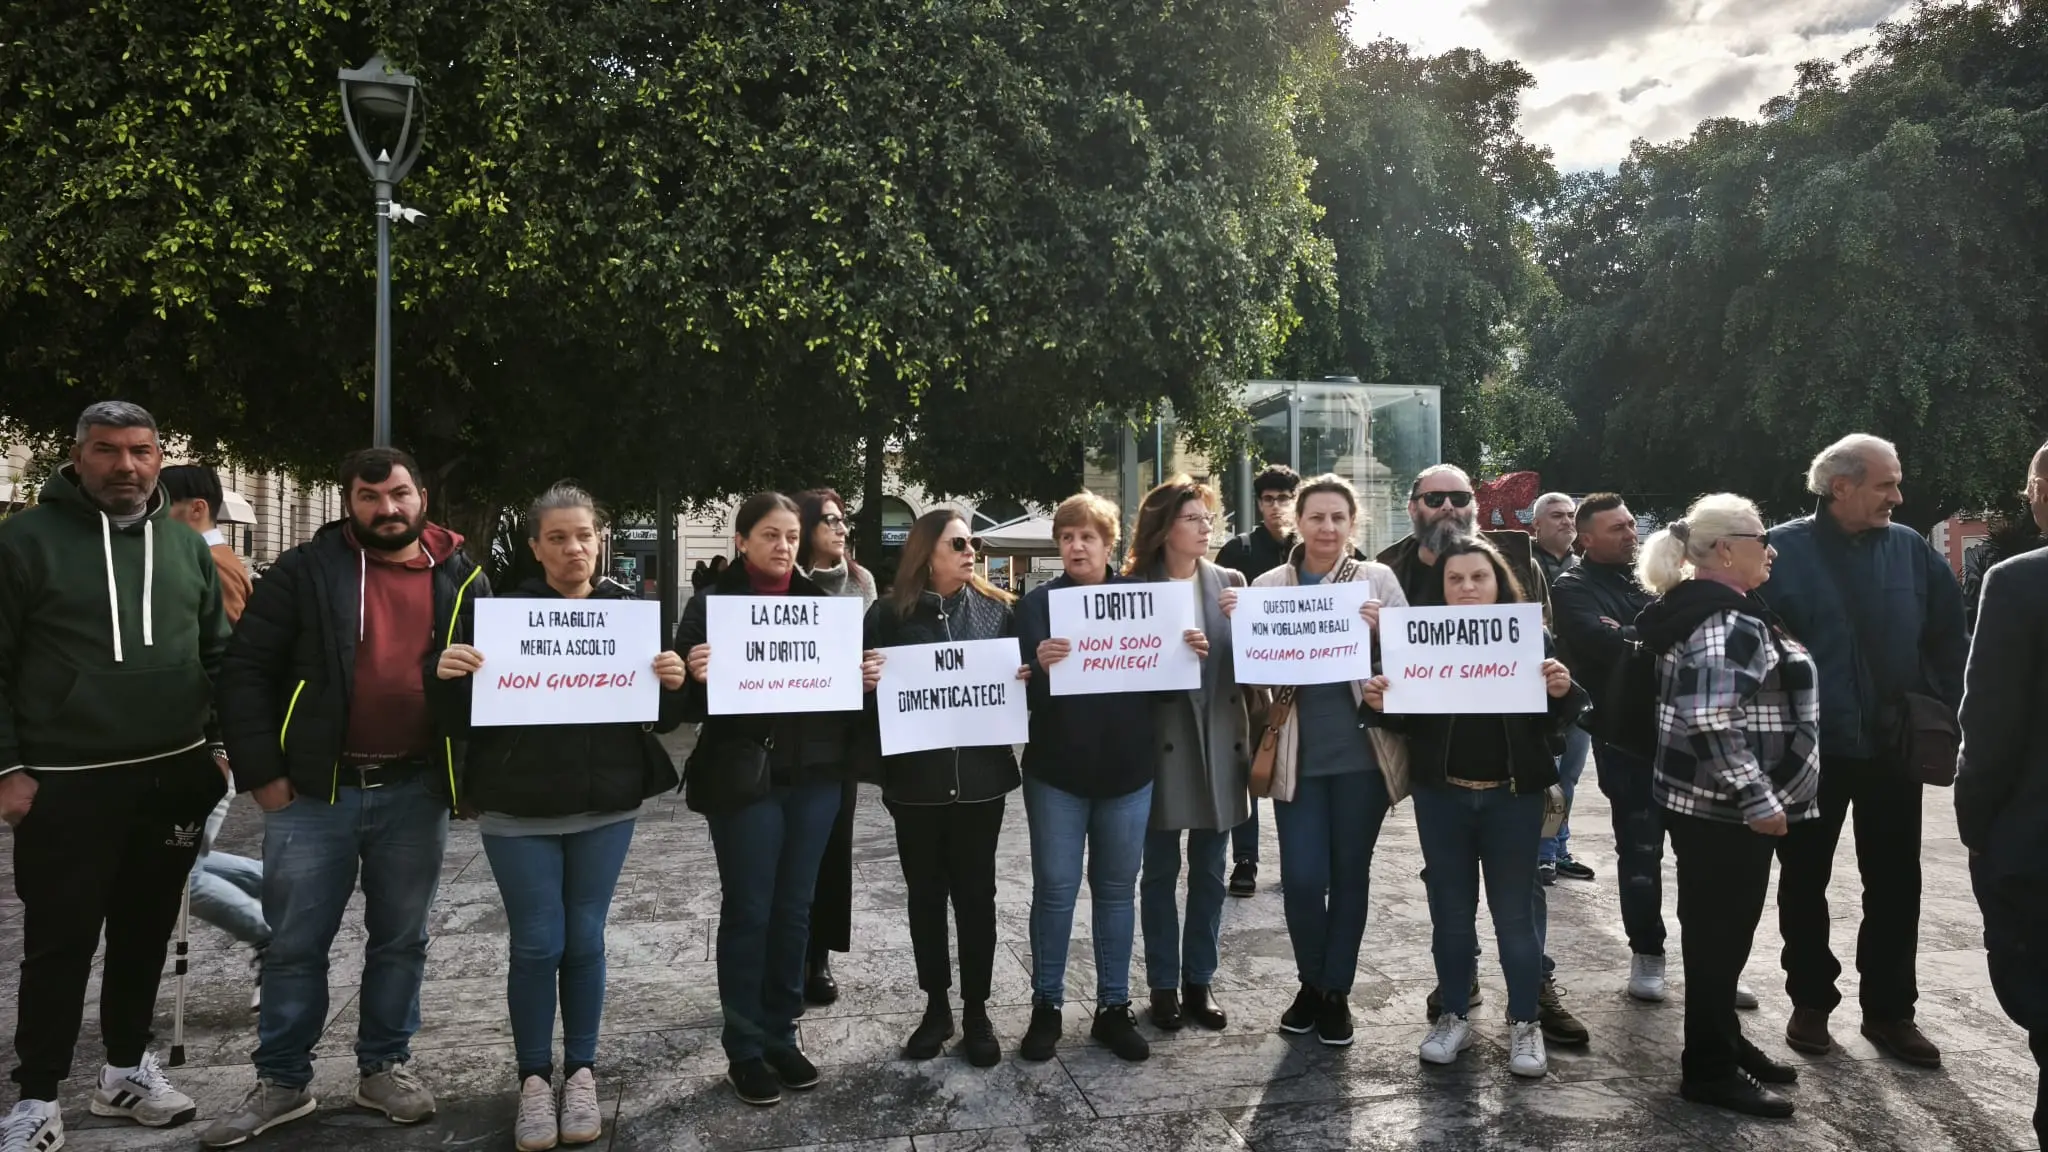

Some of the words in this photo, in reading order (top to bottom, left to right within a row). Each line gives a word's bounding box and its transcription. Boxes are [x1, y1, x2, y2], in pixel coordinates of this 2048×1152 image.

[751, 604, 769, 626] LA
[774, 604, 809, 626] CASA
[813, 601, 819, 626] È
[1084, 594, 1090, 620] I
[1095, 592, 1154, 621] DIRITTI
[1263, 599, 1296, 615] QUESTO
[1298, 597, 1334, 613] NATALE
[529, 611, 545, 628] LA
[1251, 622, 1269, 636] NON
[1271, 620, 1316, 636] VOGLIAMO
[1407, 617, 1503, 646] COMPARTO
[1509, 616, 1520, 644] 6
[521, 639, 562, 656] MERITA
[566, 639, 616, 656] ASCOLTO
[746, 641, 765, 662] UN
[770, 640, 820, 664] DIRITTO,
[1078, 635, 1113, 652] NON
[1119, 633, 1162, 651] SONO
[1245, 647, 1305, 661] VOGLIAMO
[1309, 642, 1358, 660] DIRITTI!
[935, 648, 964, 672] NON
[1082, 653, 1159, 672] PRIVILEGI!
[1404, 663, 1434, 679] NOI
[1439, 664, 1454, 679] CI
[1459, 661, 1517, 679] SIAMO!
[497, 672, 541, 689] NON
[546, 670, 636, 691] GIUDIZIO!
[739, 679, 764, 690] NON
[768, 678, 784, 690] UN
[788, 677, 832, 689] REGALO!
[898, 683, 1006, 713] DIMENTICATECI!
